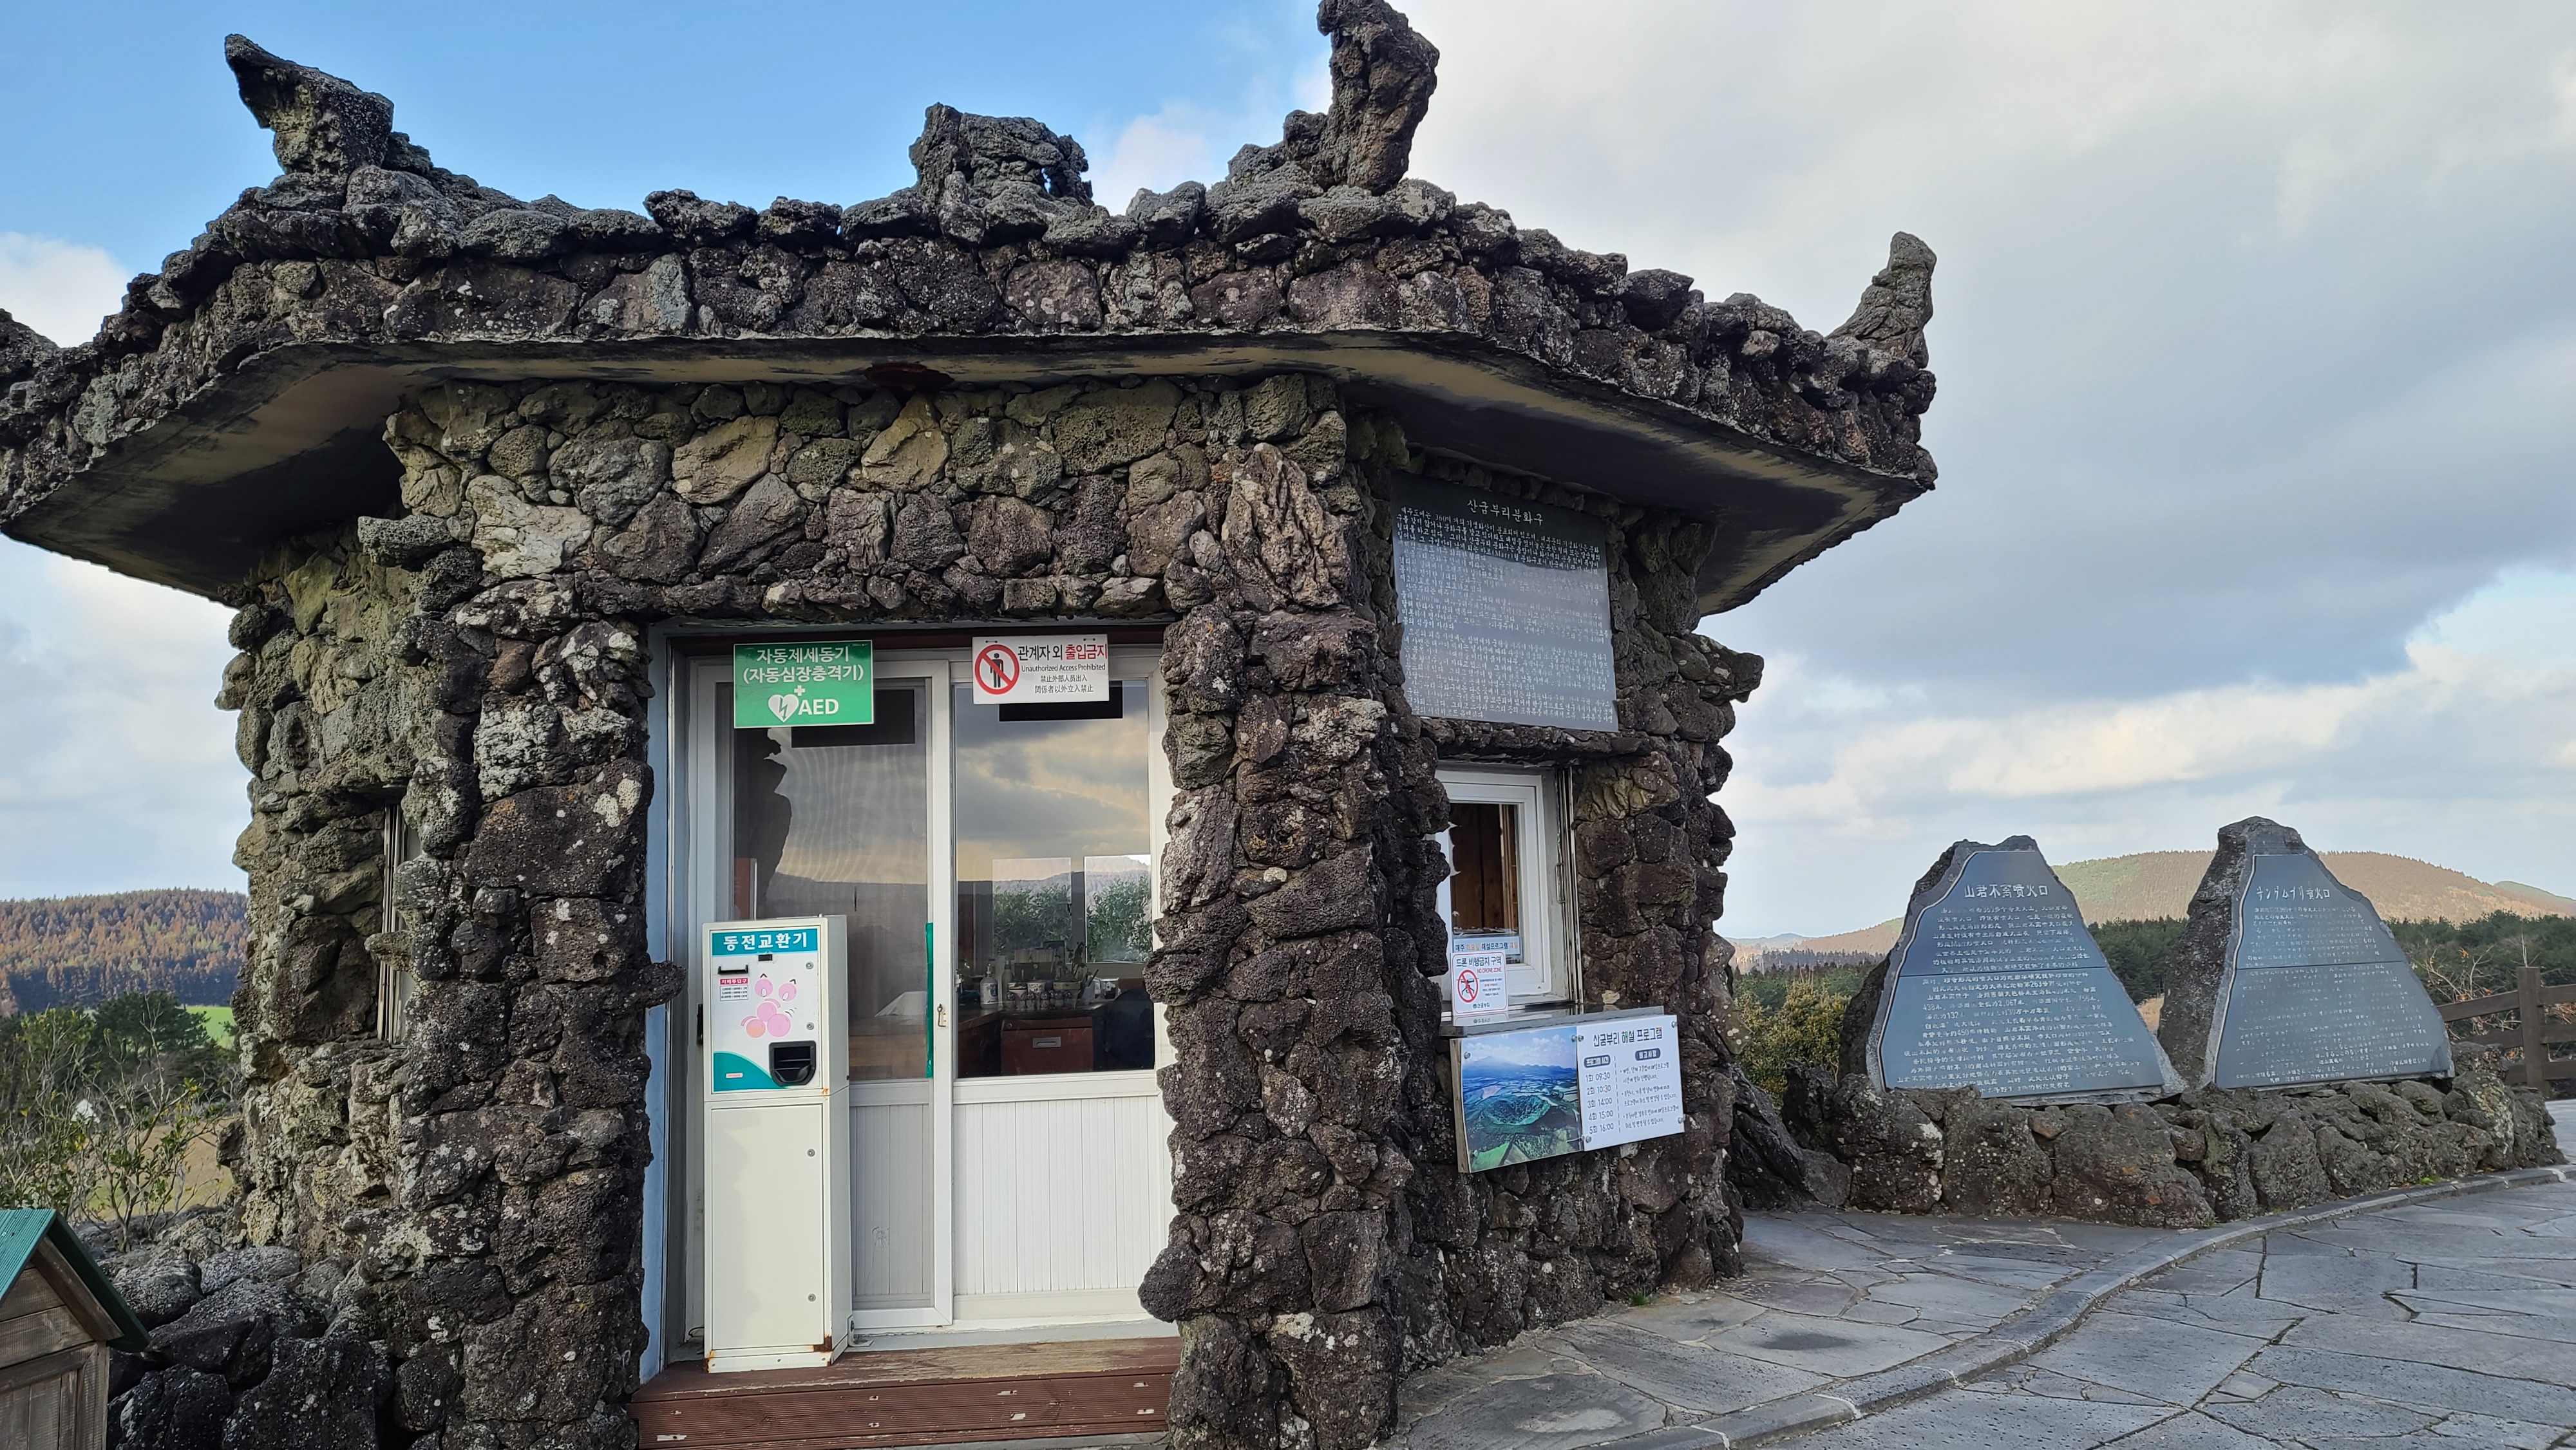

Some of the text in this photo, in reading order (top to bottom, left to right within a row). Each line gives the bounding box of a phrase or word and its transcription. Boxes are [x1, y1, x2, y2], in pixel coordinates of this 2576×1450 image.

[757, 646, 849, 664] 자동제세동기
[1018, 644, 1107, 661] 관계자 외 출입금지
[743, 664, 864, 684] (자동심장충격기)
[1041, 674, 1088, 683] 禁止外部人员出入
[798, 699, 838, 715] AED
[723, 932, 807, 951] 동전교환기
[1456, 956, 1502, 966] 드론 비행금지 구역
[1593, 1027, 1662, 1047] 산굼부리 해설 프로그램
[1596, 1072, 1610, 1080] 09:30
[1587, 1087, 1595, 1095] 2회
[1587, 1100, 1595, 1108] 3회
[1589, 1110, 1613, 1121] 4회 15:00
[1589, 1123, 1614, 1134] 5회 16:00
